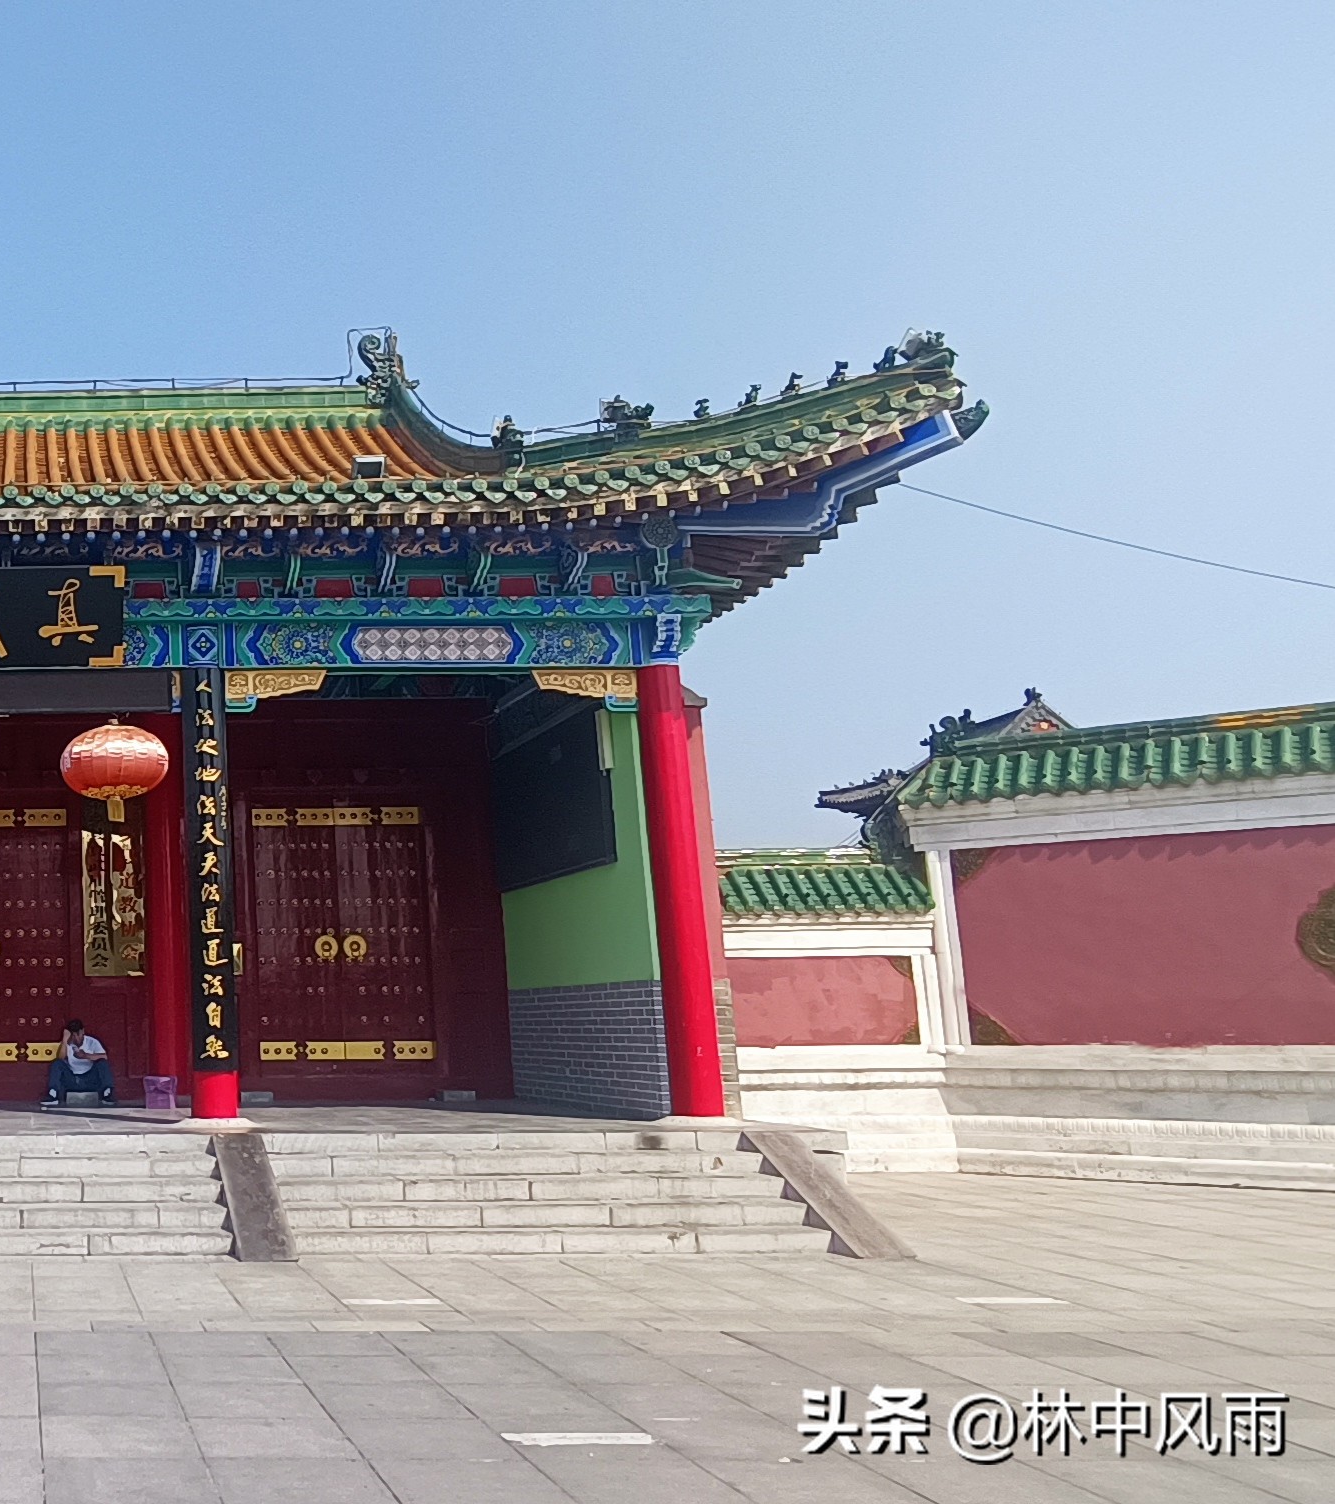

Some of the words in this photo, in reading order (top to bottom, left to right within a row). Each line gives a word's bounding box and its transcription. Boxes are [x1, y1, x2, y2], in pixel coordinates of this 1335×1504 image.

[194, 679, 230, 1059] 人法地地法天天法道道法自然
